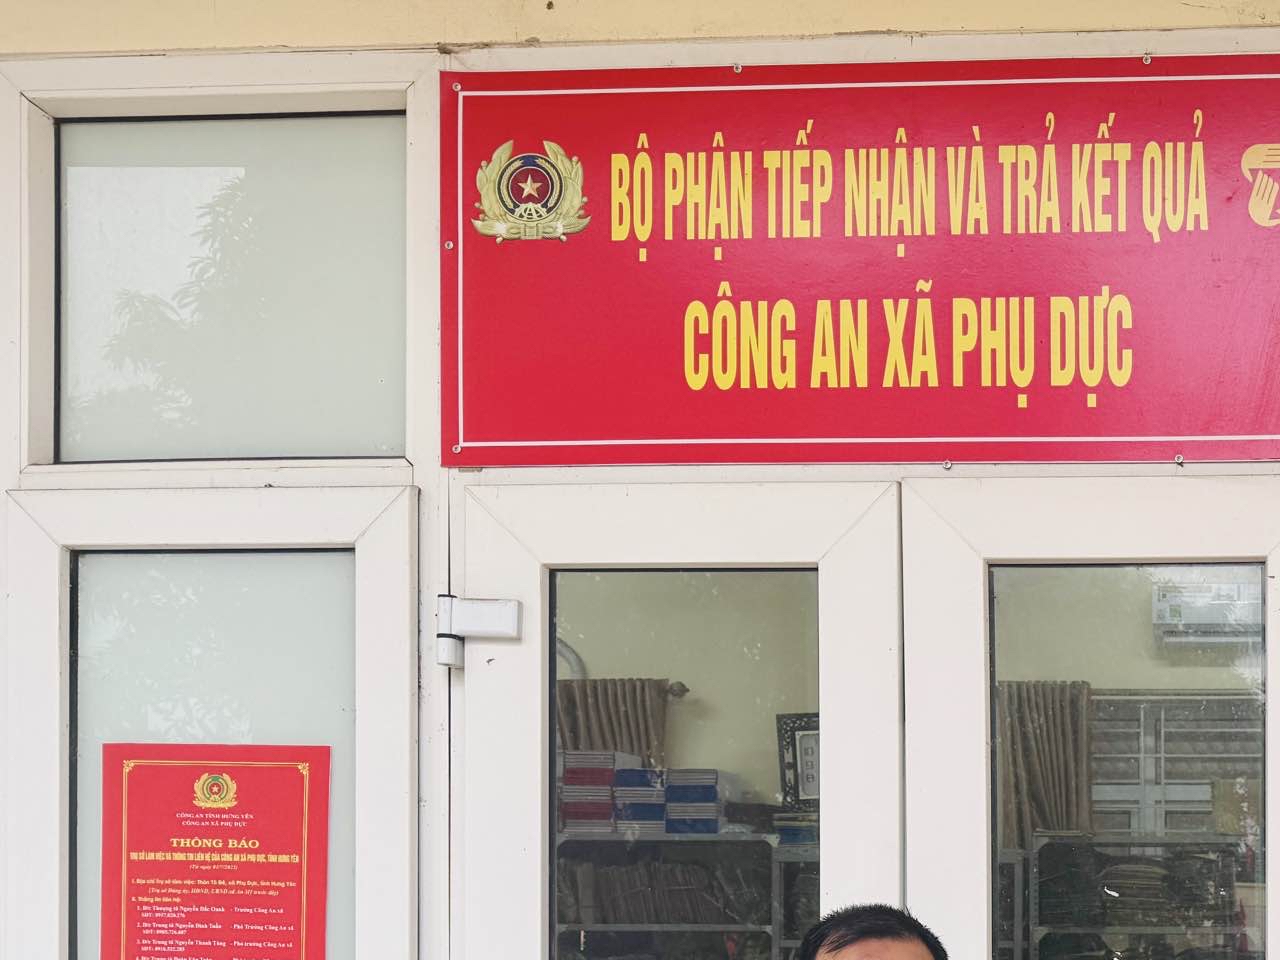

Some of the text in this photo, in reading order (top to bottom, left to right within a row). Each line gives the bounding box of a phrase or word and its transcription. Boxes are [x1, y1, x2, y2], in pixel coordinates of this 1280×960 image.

[610, 109, 1209, 262] BỘ PHẬN TIẾP NHẬN VÀ TRẢ KẾT QUẢ
[683, 279, 1133, 408] CÔNG AN XÃ PHỤ DỰC
[169, 836, 260, 849] THÔNG BÁO
